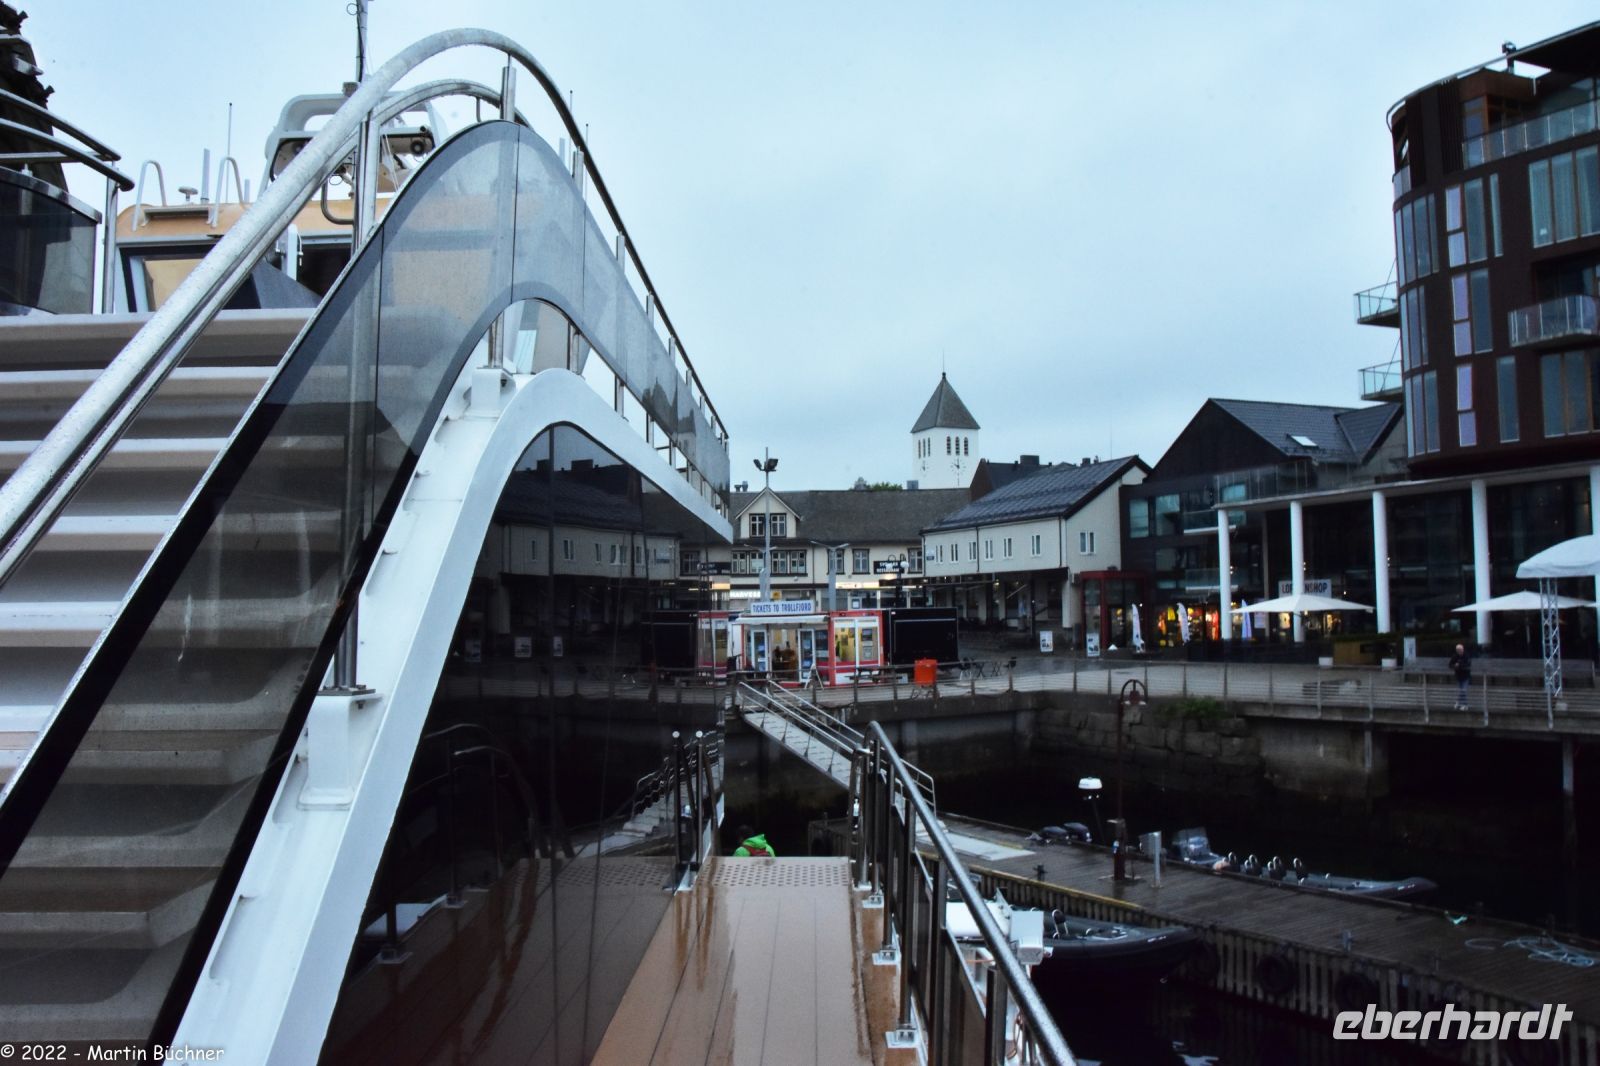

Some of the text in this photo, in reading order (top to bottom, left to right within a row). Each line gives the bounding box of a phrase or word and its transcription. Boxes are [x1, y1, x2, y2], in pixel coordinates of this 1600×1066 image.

[752, 602, 812, 613] TICKETS TO TROLLFJORD
